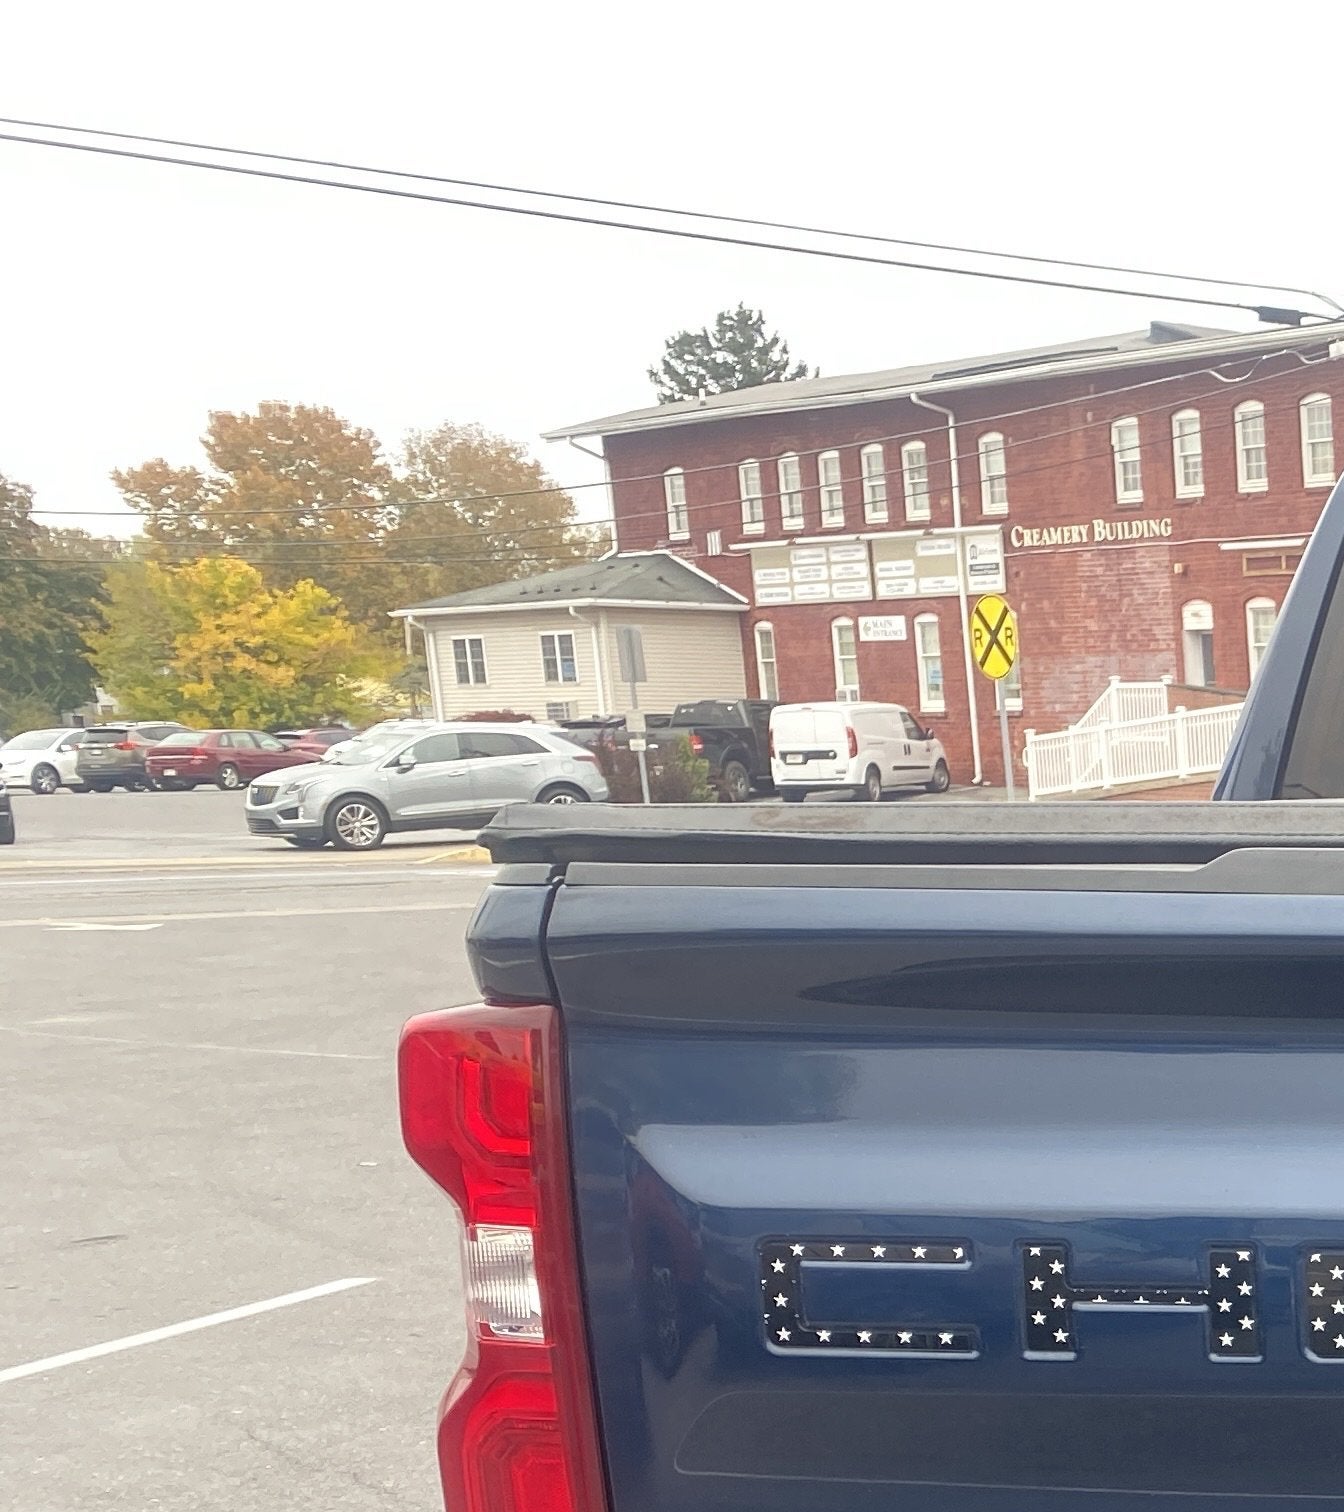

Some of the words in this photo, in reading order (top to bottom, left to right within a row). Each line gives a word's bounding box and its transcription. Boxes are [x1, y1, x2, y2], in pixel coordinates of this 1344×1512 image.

[1011, 524, 1090, 548] CREAMERY
[1092, 518, 1172, 542] BUILDING
[872, 620, 893, 628] MAIN
[974, 628, 983, 647] R
[1004, 627, 1014, 646] R
